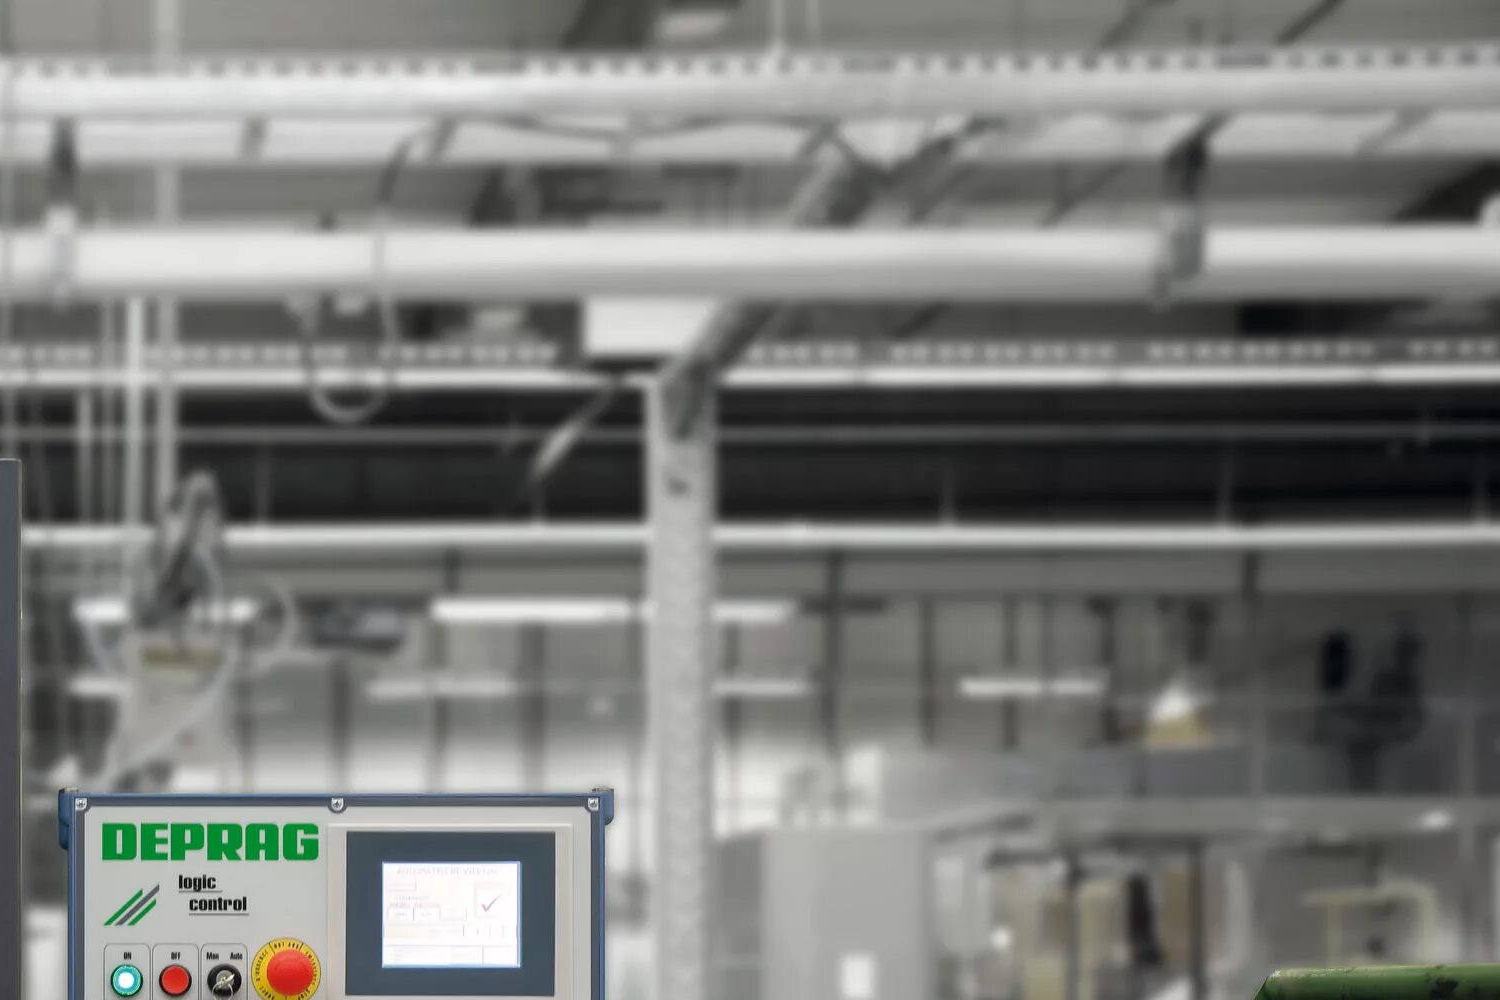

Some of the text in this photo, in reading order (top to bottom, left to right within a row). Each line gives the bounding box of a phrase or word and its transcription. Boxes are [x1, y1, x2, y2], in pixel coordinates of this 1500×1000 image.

[101, 822, 320, 861] DEPRAG
[178, 874, 217, 892] logic
[188, 896, 247, 911] control
[123, 951, 132, 960] ON
[170, 951, 181, 960] OFF
[229, 951, 243, 960] Auto
